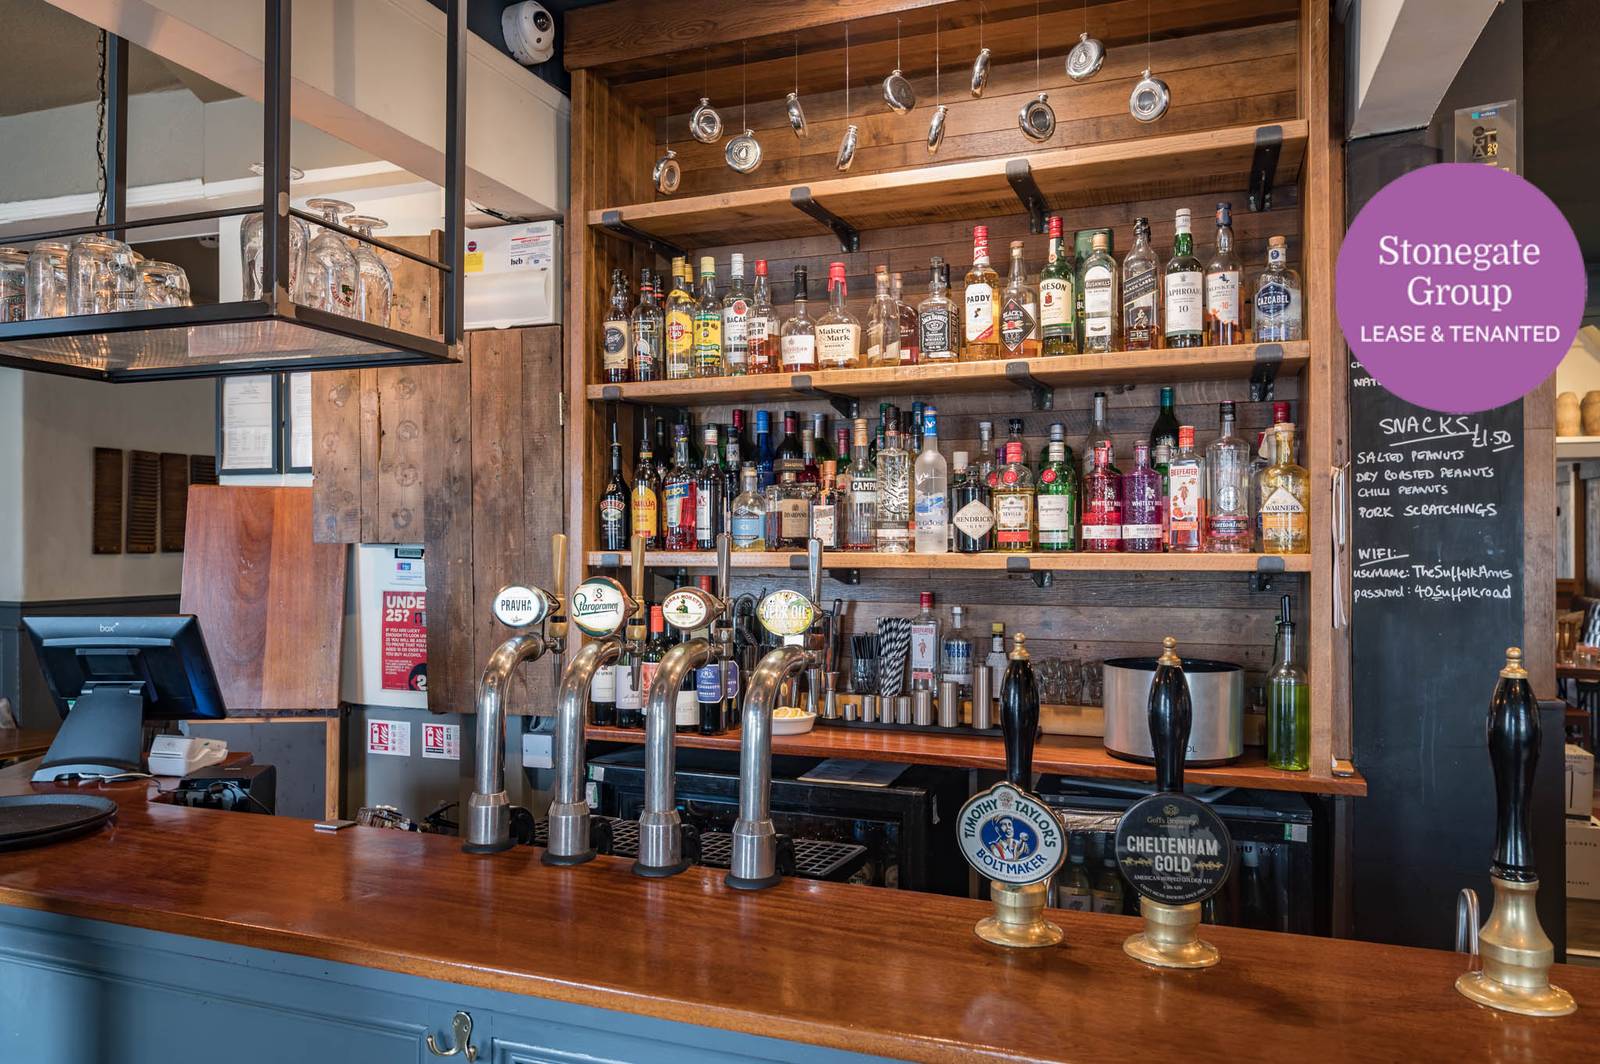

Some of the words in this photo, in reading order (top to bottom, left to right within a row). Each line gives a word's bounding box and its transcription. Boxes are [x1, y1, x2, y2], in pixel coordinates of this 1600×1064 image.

[966, 294, 990, 304] PADDY
[1258, 296, 1289, 306] CAZCABEL
[1379, 416, 1470, 435] SNACKS
[1472, 424, 1511, 448] £1.50
[1357, 452, 1404, 464] SALTED
[1412, 450, 1464, 462] PEANUTS
[1170, 468, 1198, 477] BEEFEATER
[1356, 472, 1378, 482] DRY
[1384, 469, 1434, 481] ROASTED
[1440, 466, 1494, 479] PEANUTS
[1358, 487, 1390, 498] CHILLI
[1398, 484, 1448, 496] PEANUTS
[1359, 506, 1394, 518] PORK
[1403, 503, 1498, 517] SCRATCHINGS
[1354, 570, 1410, 579] username:
[1412, 565, 1512, 582] TheSuffolkArms
[1414, 585, 1512, 602] 40Suffolkroad
[501, 600, 532, 611] PRAVHA
[573, 592, 619, 618] Staropramen
[792, 605, 807, 620] OIL
[386, 609, 410, 622] 25?
[964, 798, 998, 838] TIMOTHY
[1014, 800, 1056, 848] TAYLOR'S
[1127, 836, 1218, 856] CHELTENHAM
[976, 848, 1048, 874] BOLTMAKER
[1154, 855, 1191, 872] GOLD
